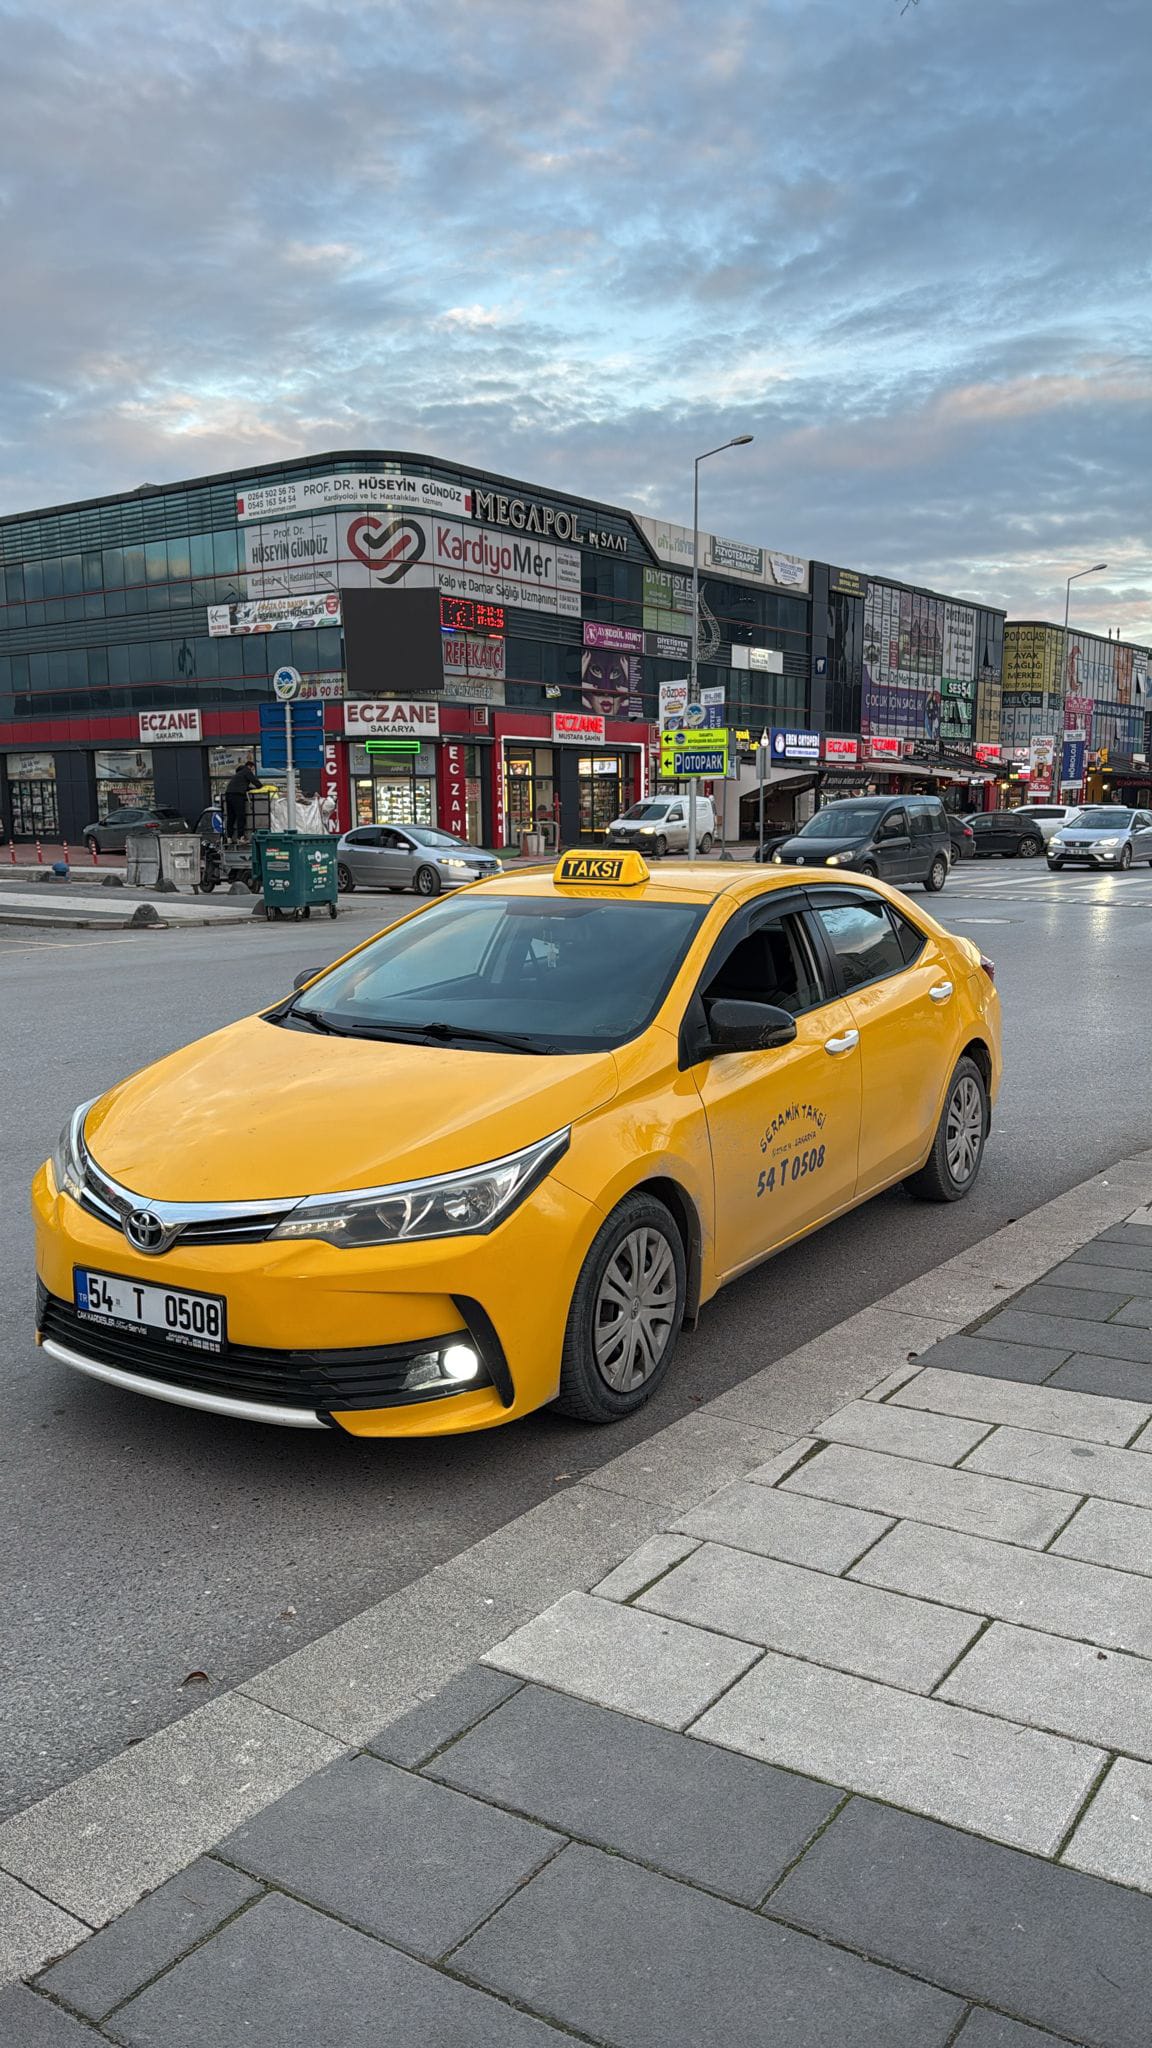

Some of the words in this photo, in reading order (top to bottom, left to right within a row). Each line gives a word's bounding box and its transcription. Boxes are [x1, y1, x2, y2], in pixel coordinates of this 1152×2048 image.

[248, 491, 264, 501] 0264
[303, 481, 331, 495] PROF.
[333, 479, 354, 491] DR.
[358, 476, 416, 492] HÜSEYİN
[421, 481, 462, 502] GÜNDÜZ
[323, 493, 359, 503] Kardiyoloji
[379, 493, 420, 503] Hastalıkları
[248, 500, 264, 510] 0545
[278, 496, 287, 505] 54
[288, 494, 297, 503] 54
[474, 490, 584, 543] MEGAPOL
[273, 527, 292, 539] Prof.
[293, 525, 305, 536] Dr.
[252, 541, 290, 564] HÜSEYİN
[290, 536, 328, 559] GÜNDÜZ
[437, 526, 552, 578] KardiyoMer
[438, 573, 457, 590] Kalp
[457, 578, 467, 590] ve
[468, 580, 494, 595] Damar
[495, 583, 519, 601] Sağlığı
[520, 588, 558, 606] Uzmanınız
[1007, 660, 1043, 670] SAĞLIĞI
[320, 686, 331, 697] 90
[140, 712, 198, 731] ECZANE
[346, 702, 438, 725] ECZANE
[476, 709, 485, 723] E
[370, 724, 416, 733] SAKARYA
[555, 714, 604, 734] ECZANE
[155, 732, 184, 740] SAKARYA
[558, 733, 585, 742] MUSTAFA
[585, 733, 601, 743] ŞAHİN
[785, 733, 798, 746] EREN
[827, 740, 857, 753] ECZANE
[674, 753, 683, 771] P
[684, 754, 723, 771] OTOPARK
[448, 746, 461, 838] ECZAN
[760, 1102, 800, 1153] SERAMİK
[801, 1103, 827, 1130] TAKSİ
[757, 1166, 776, 1198] 54
[780, 1158, 789, 1186] T
[791, 1144, 826, 1181] 0508
[78, 1292, 88, 1304] TR
[88, 1277, 113, 1312] 54
[132, 1287, 145, 1320] T
[165, 1295, 219, 1337] 0508
